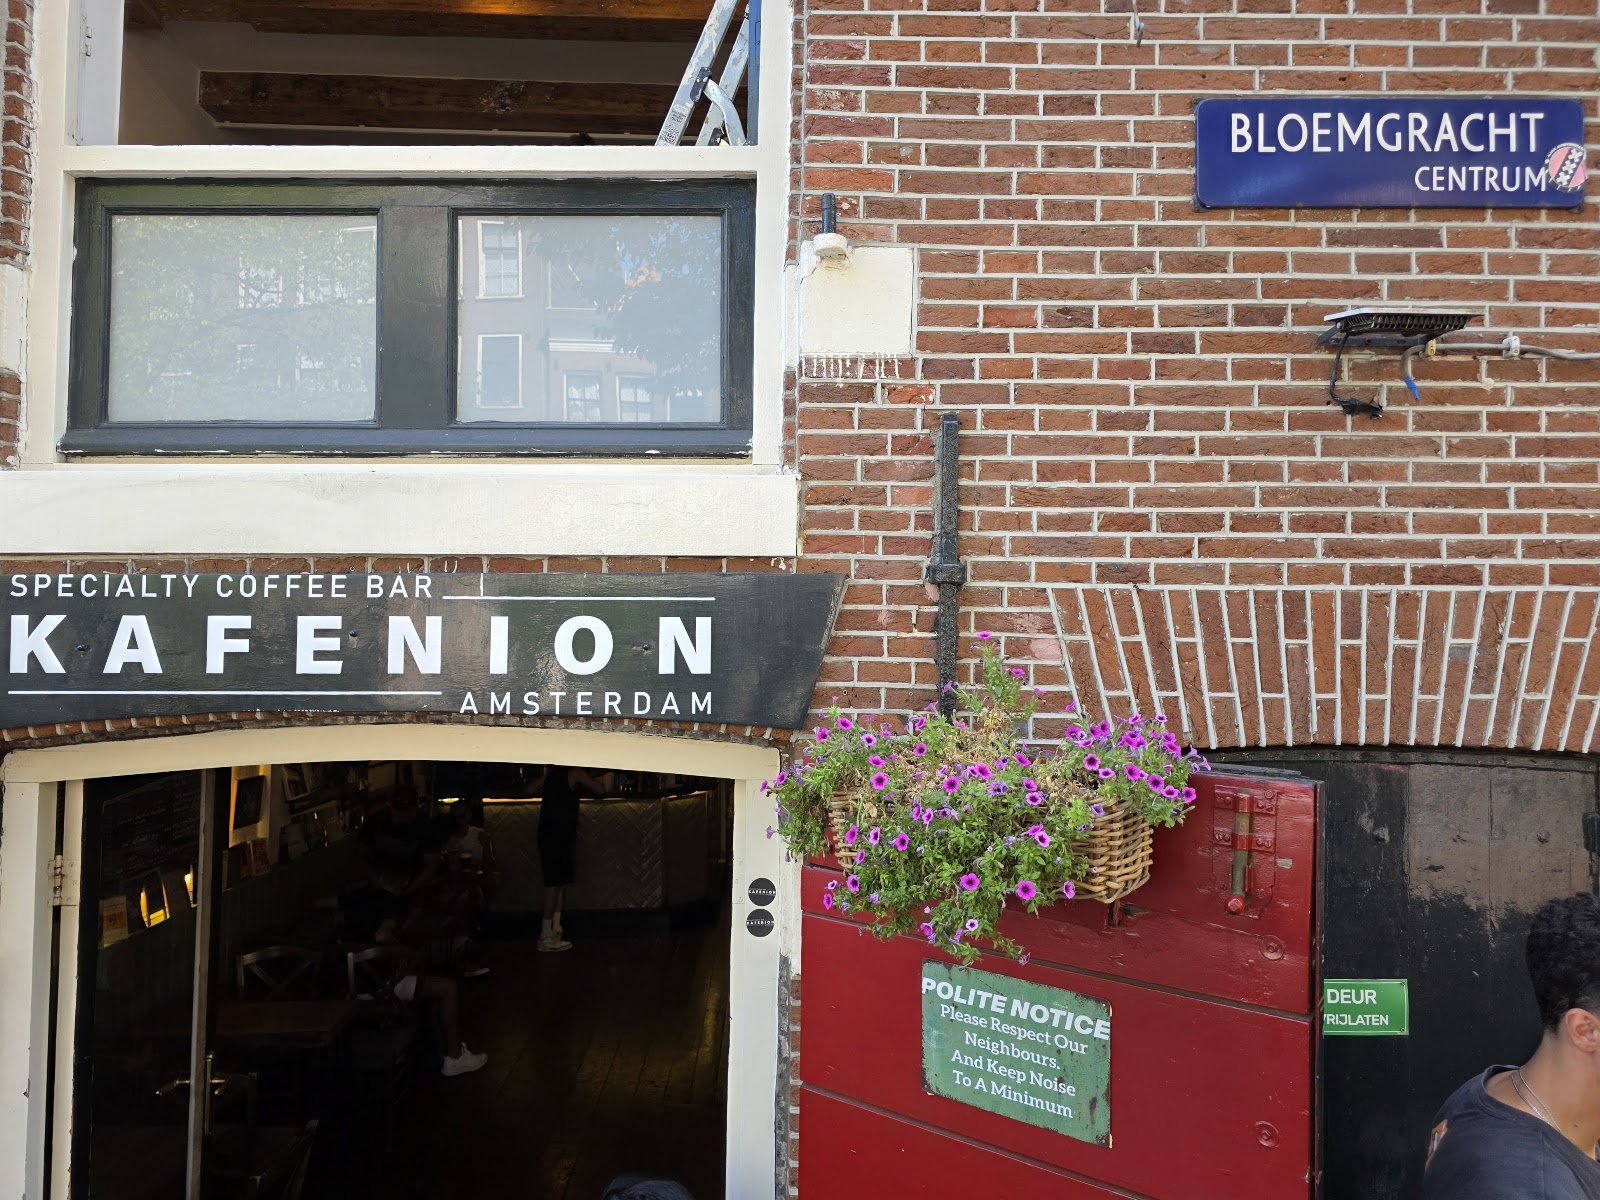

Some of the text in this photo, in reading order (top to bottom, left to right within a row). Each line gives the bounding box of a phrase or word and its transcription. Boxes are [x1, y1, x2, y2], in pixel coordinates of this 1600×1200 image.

[1231, 112, 1544, 153] BLOEMGRACHT
[1414, 166, 1546, 192] CENTRUM
[10, 573, 434, 599] SPECIALTY COFFEE BAR
[9, 614, 712, 676] KAFENION
[459, 691, 713, 715] AMSTERDAM
[921, 977, 1110, 1041] POLITE NOTICE
[1326, 988, 1377, 1004] DEUR
[940, 1004, 1088, 1055] Please Respect Our
[964, 1031, 1060, 1069] Neighbours.
[951, 1050, 1076, 1096] And Keep Noise
[953, 1070, 1073, 1118] To A Minimum
